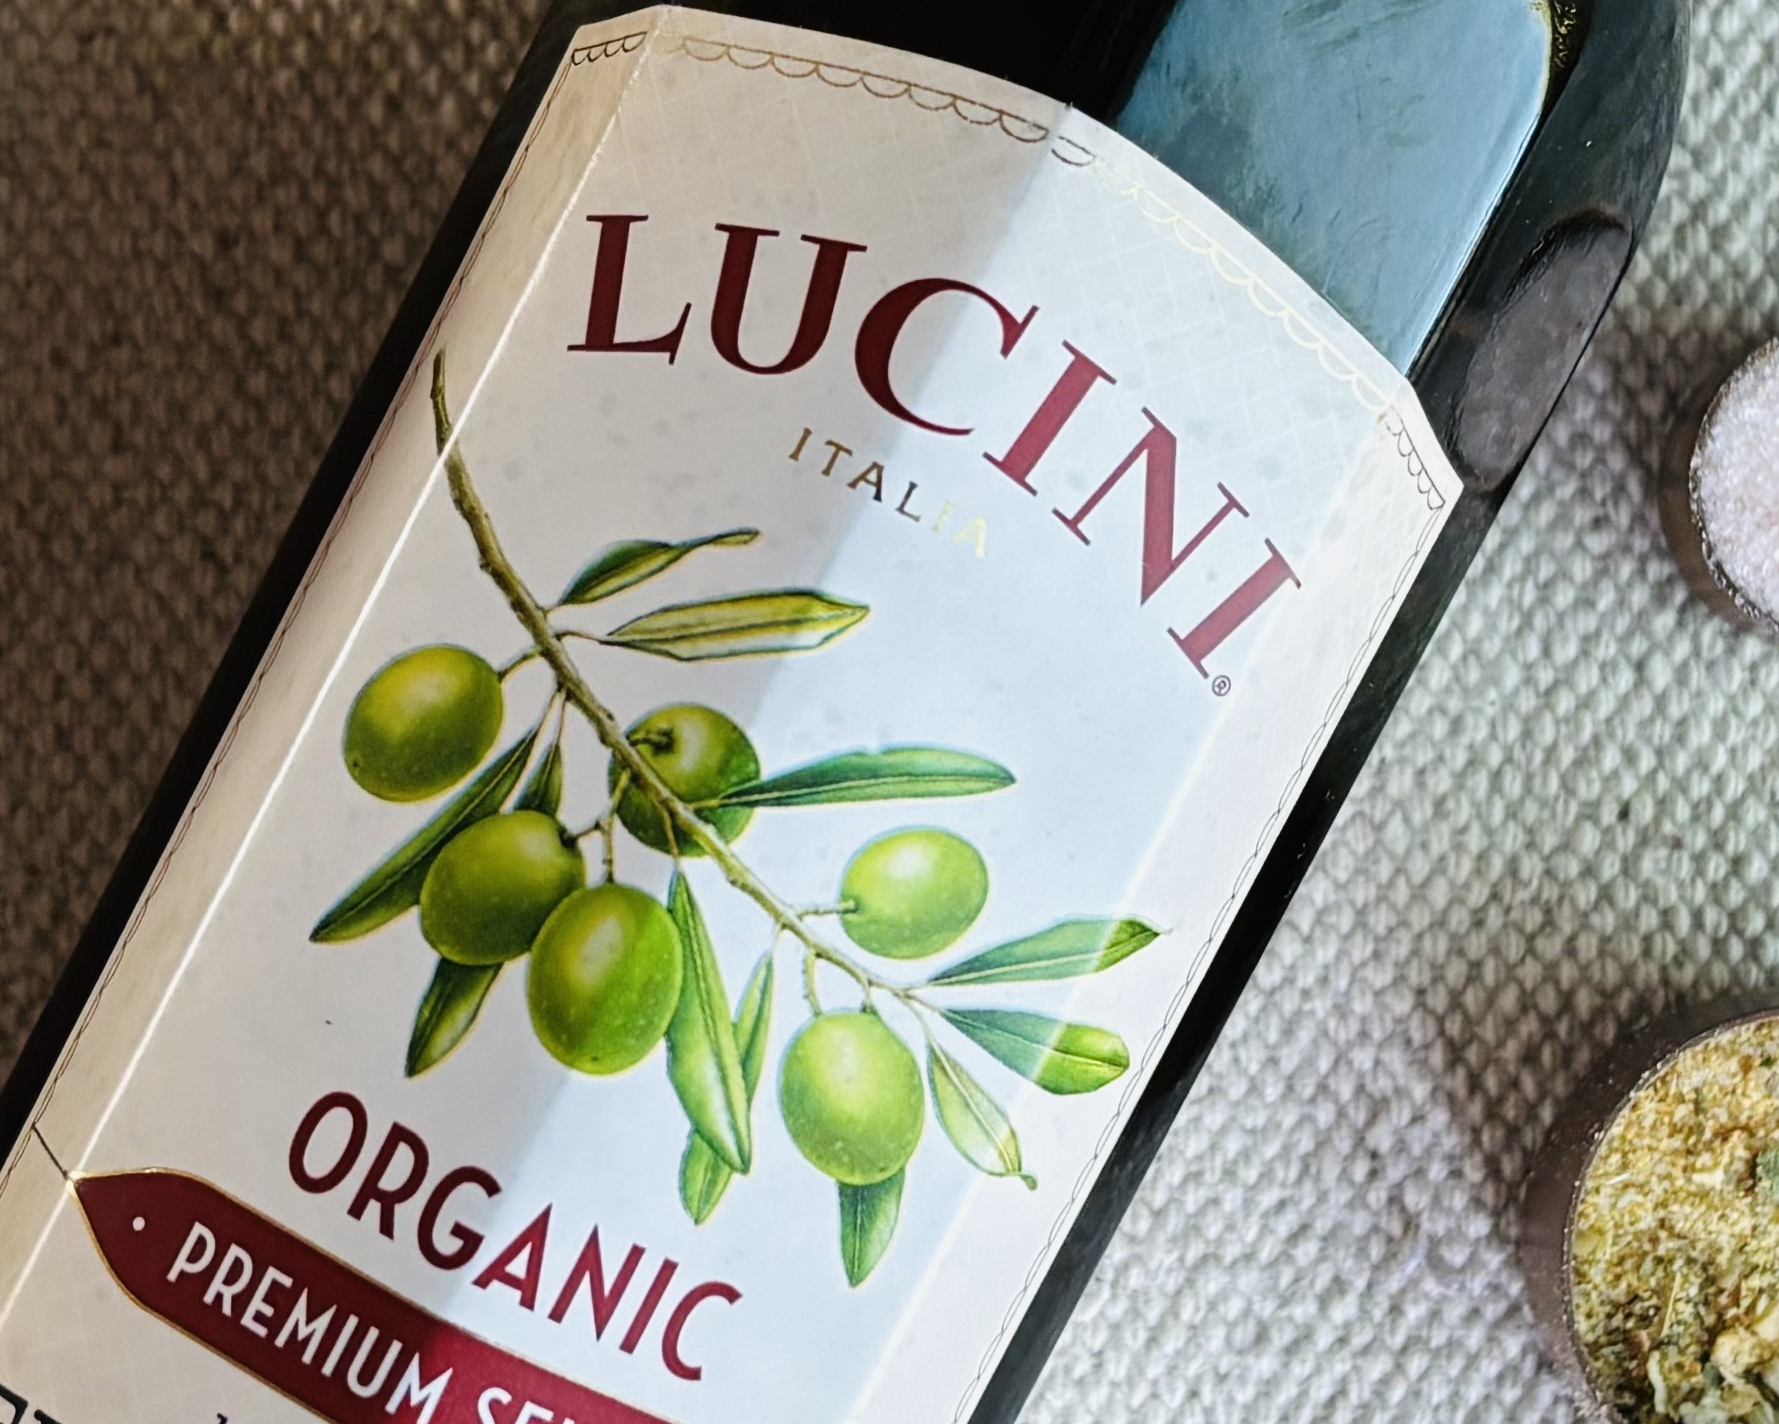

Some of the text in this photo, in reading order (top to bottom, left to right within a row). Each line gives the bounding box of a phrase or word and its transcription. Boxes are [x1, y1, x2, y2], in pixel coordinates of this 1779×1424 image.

[566, 214, 1302, 681] LUCINI
[788, 427, 988, 559] ITALIA
[287, 1091, 743, 1381] ORGANIC
